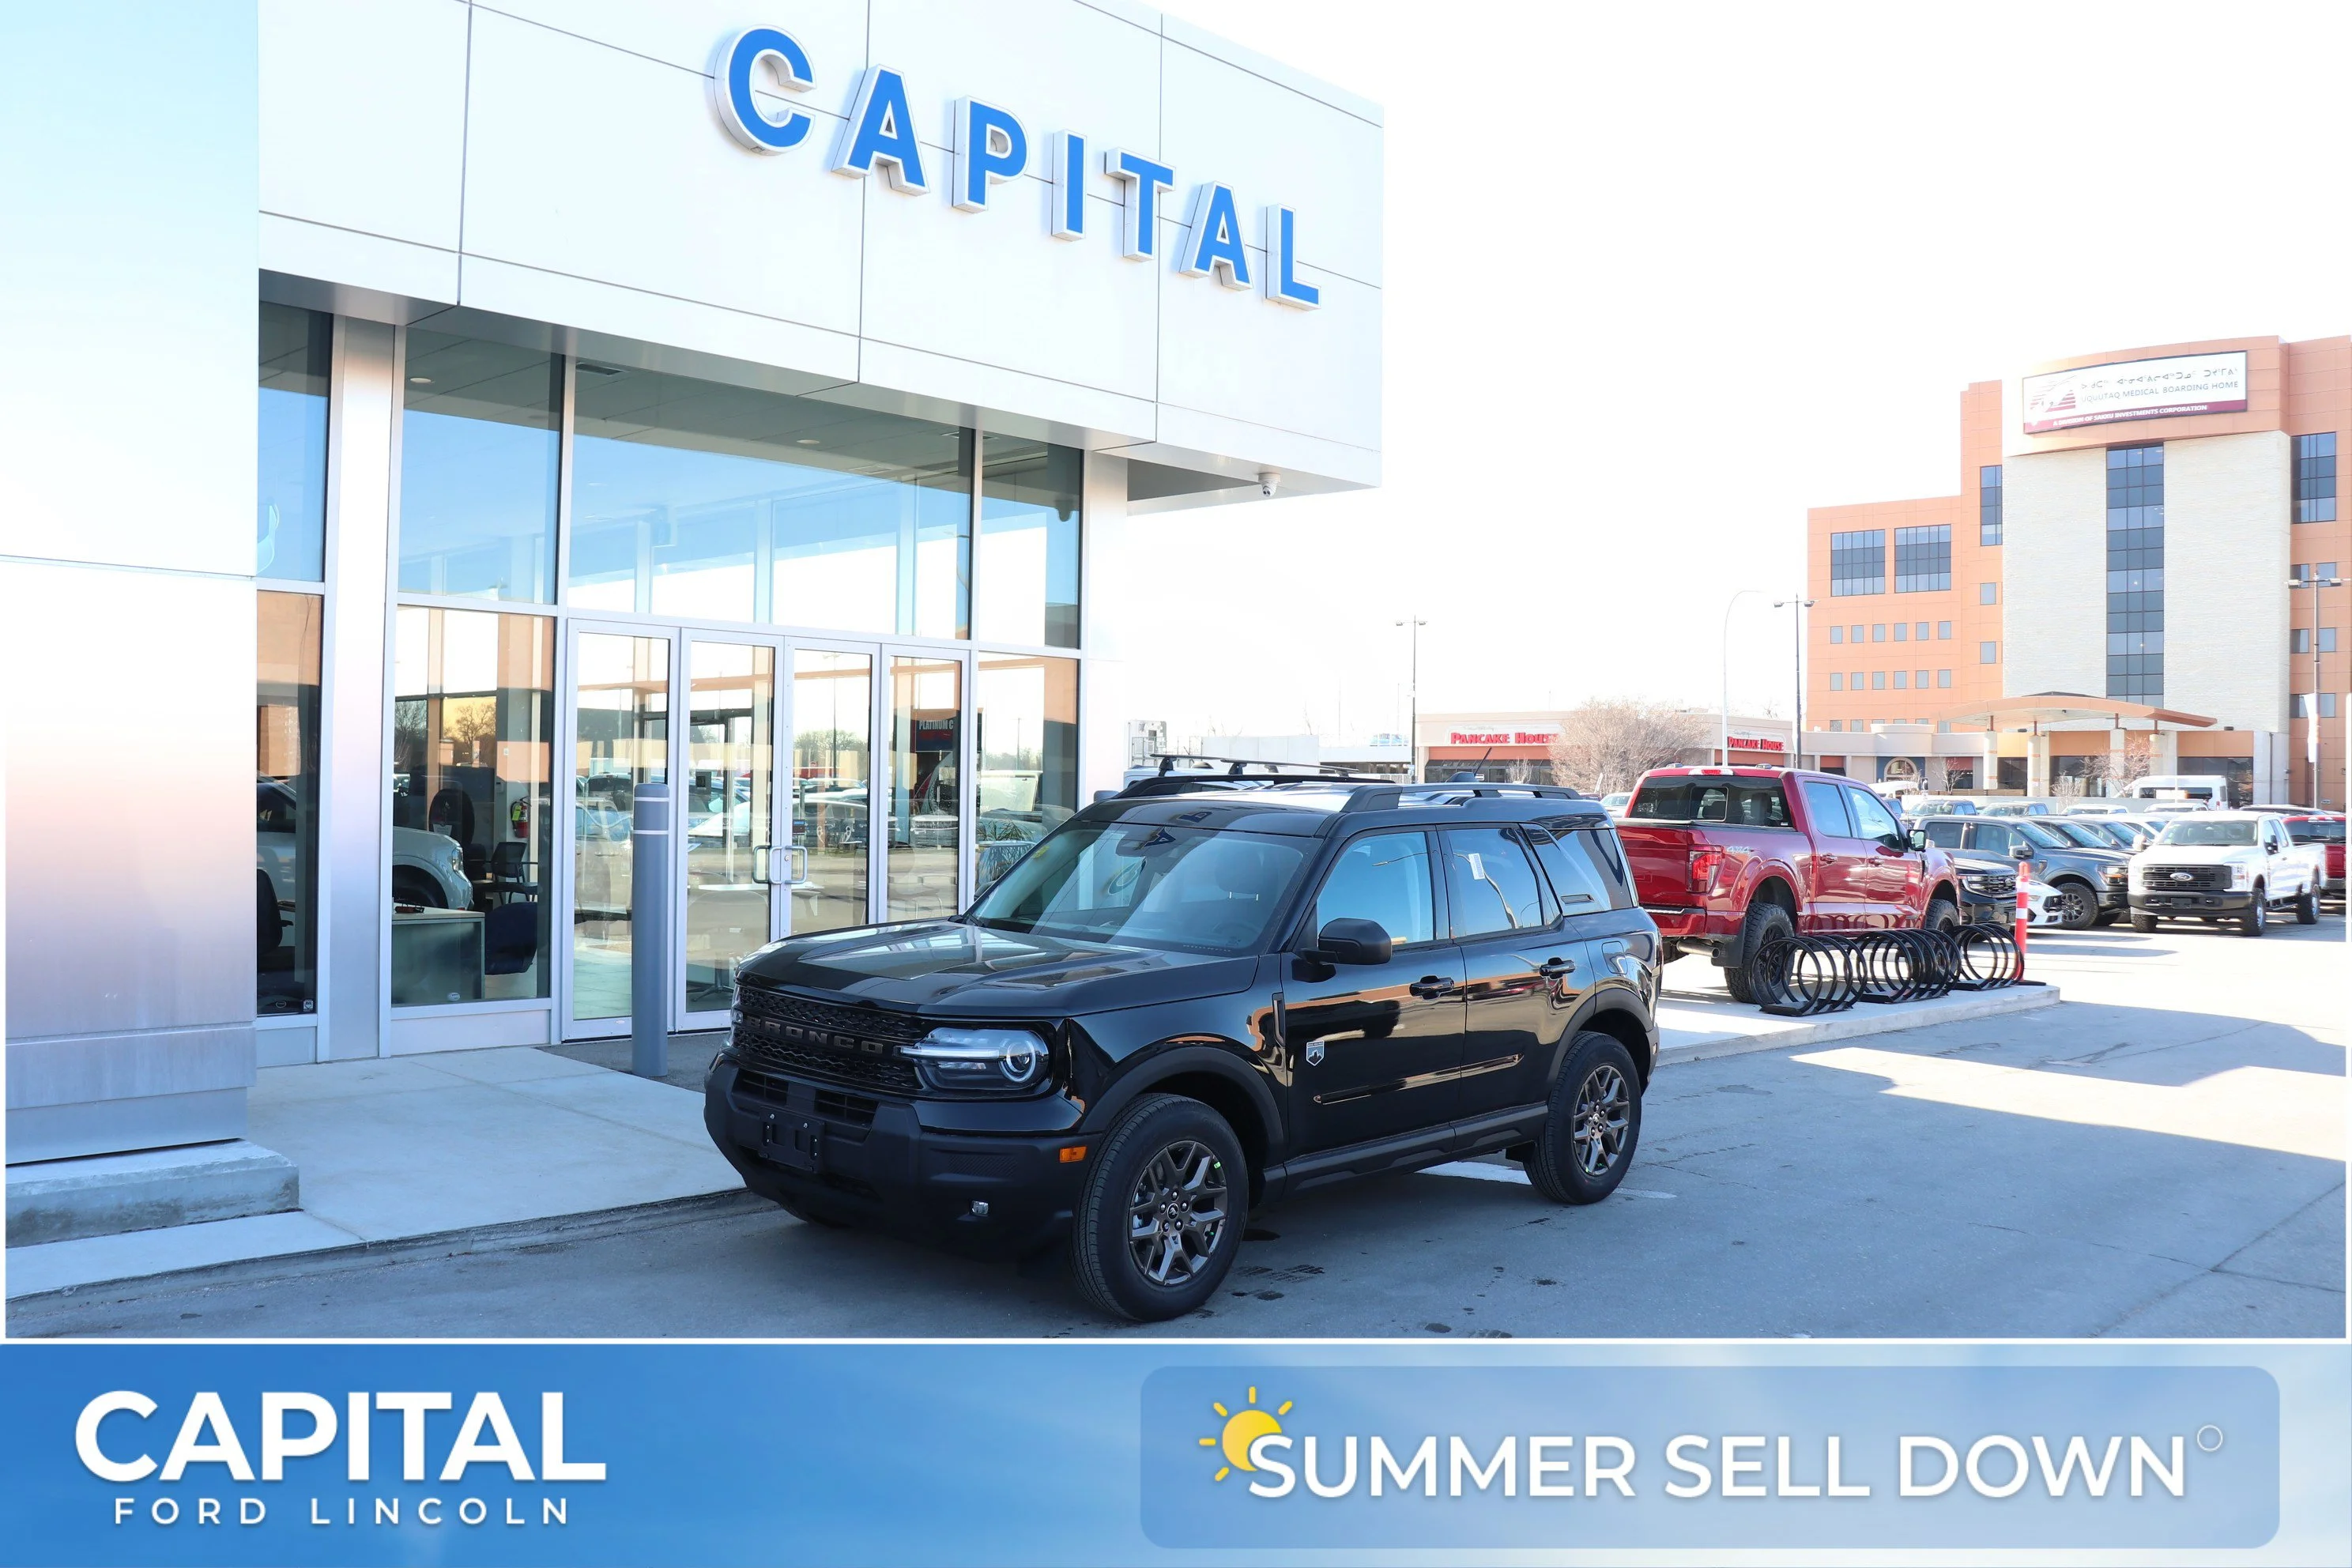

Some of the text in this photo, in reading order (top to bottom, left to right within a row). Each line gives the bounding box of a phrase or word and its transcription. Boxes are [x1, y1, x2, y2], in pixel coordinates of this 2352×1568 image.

[714, 24, 1321, 311] CAPITAL
[2122, 388, 2159, 398] MEDICAL
[2162, 383, 2209, 394] BOARDING
[2211, 381, 2239, 390] HOME
[2058, 416, 2084, 425] DIVISION
[2114, 409, 2159, 418] INVESTMENTS
[2159, 405, 2207, 413] CORPORATION
[918, 720, 948, 730] PLATINUM
[1450, 733, 1510, 744] PANCAKE
[1728, 737, 1785, 751] PANCAKE HOUSE
[746, 1016, 884, 1054] BRONCO
